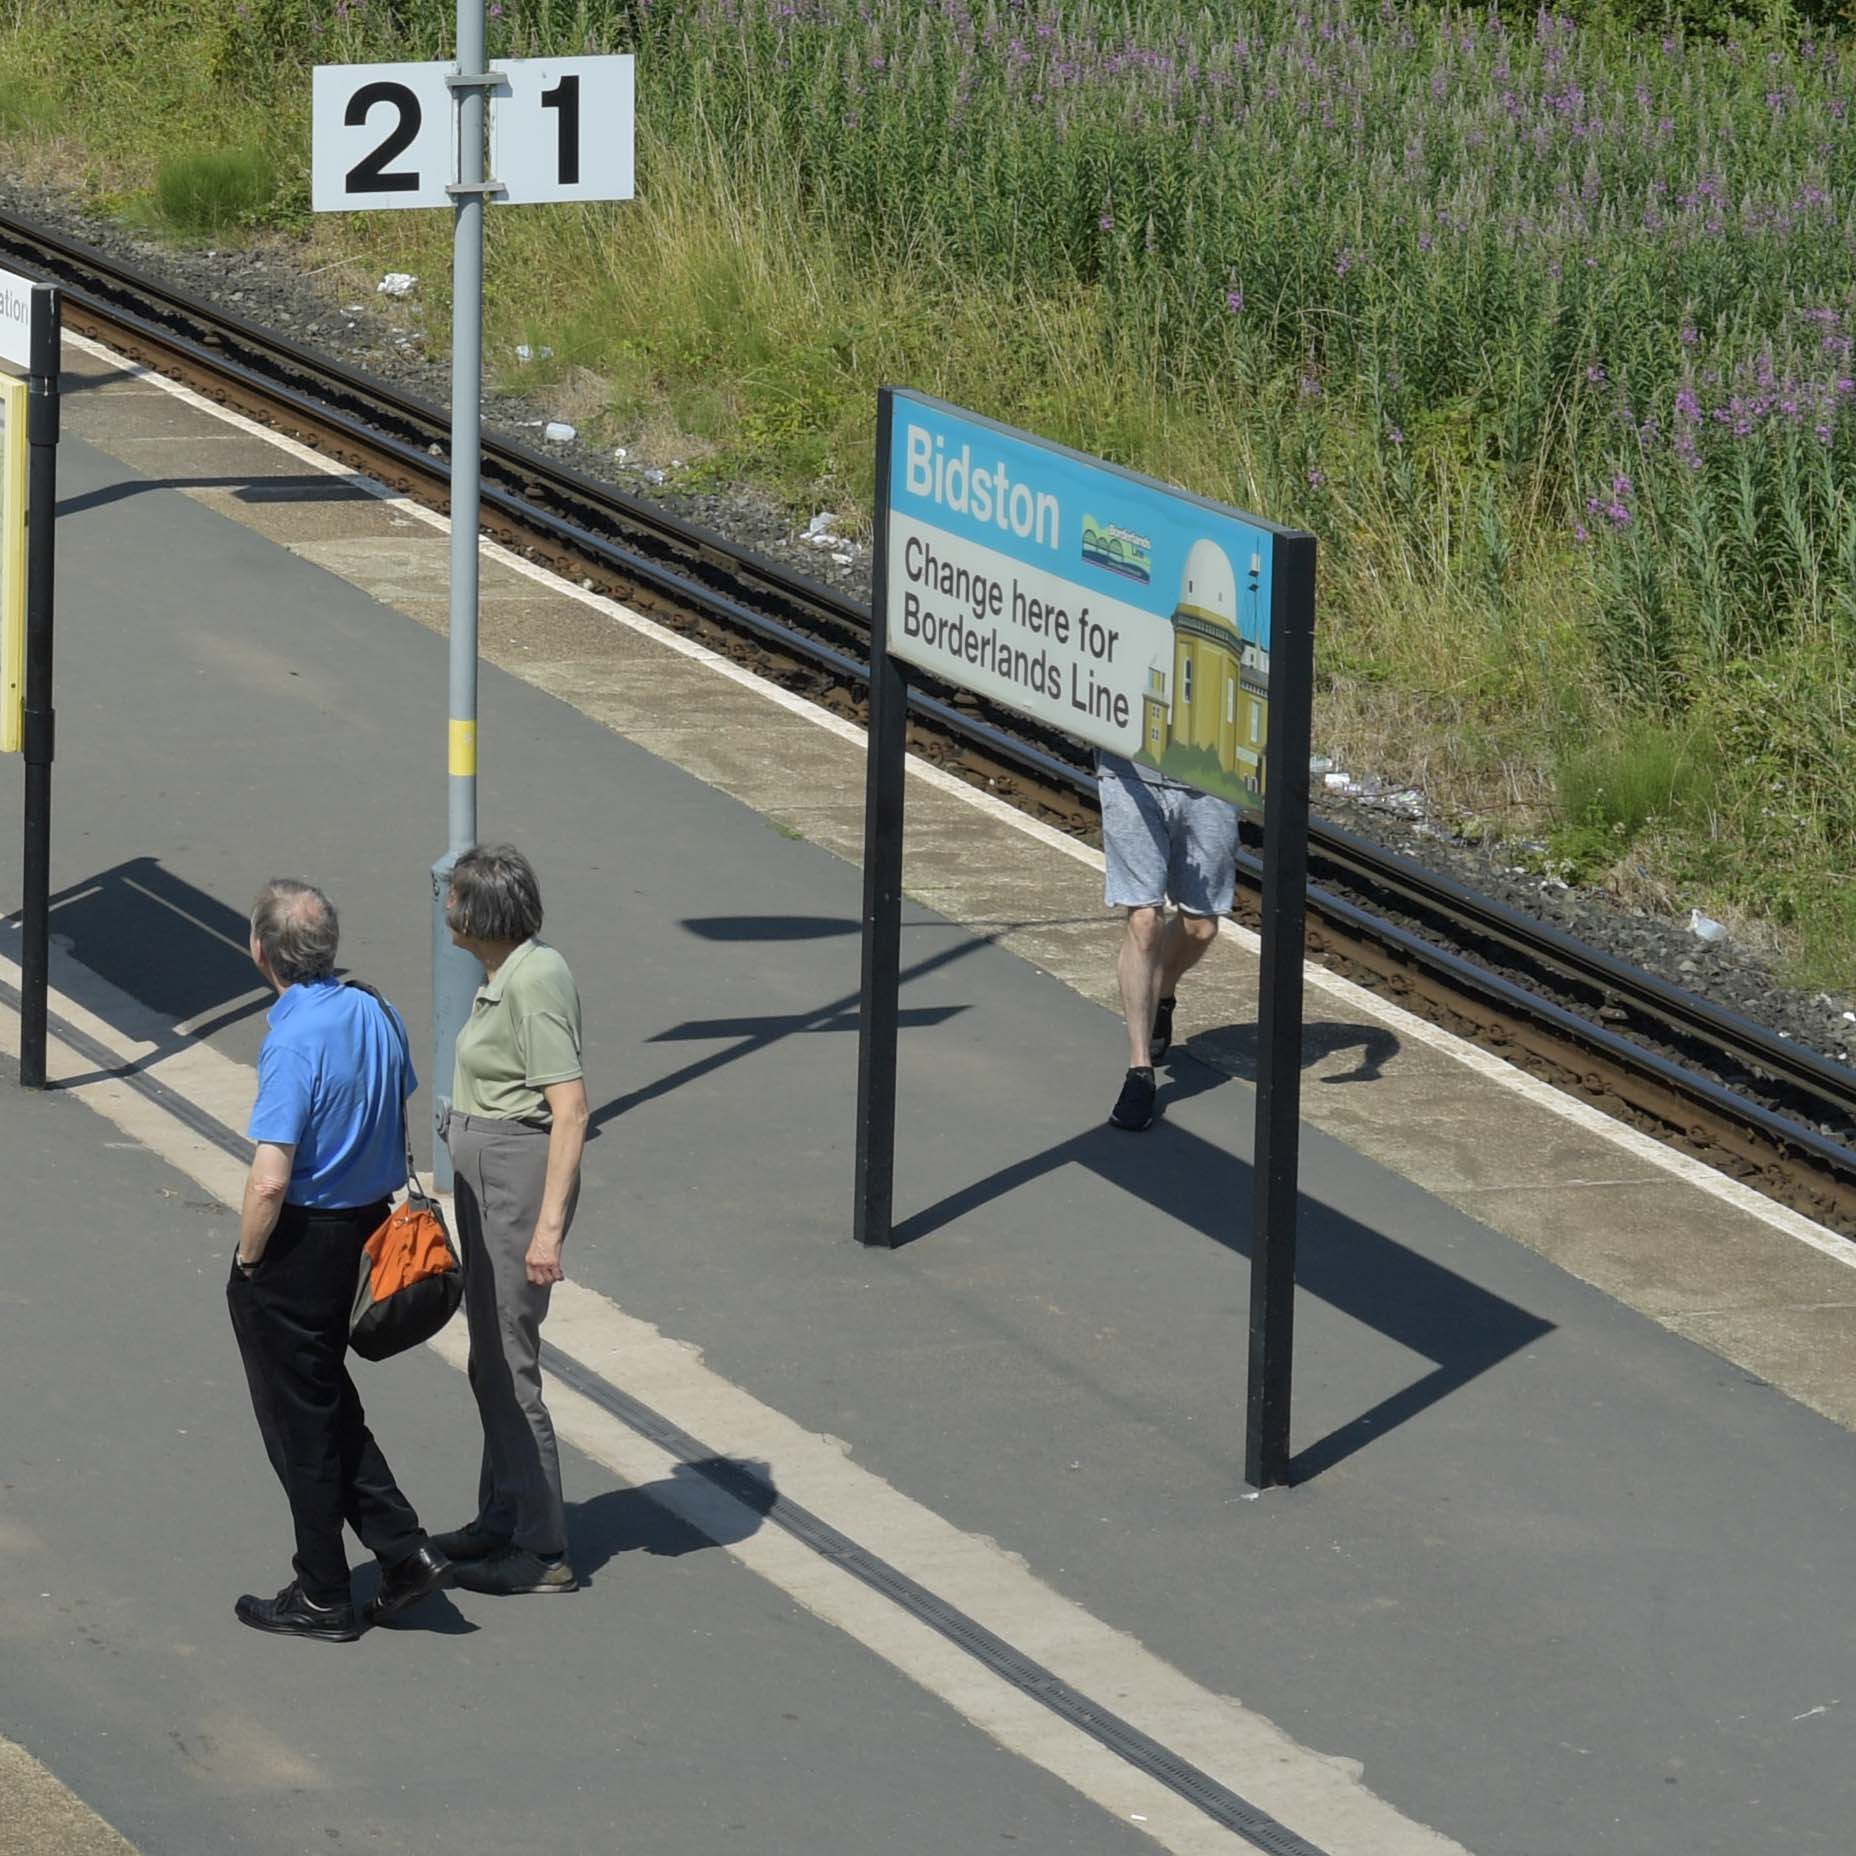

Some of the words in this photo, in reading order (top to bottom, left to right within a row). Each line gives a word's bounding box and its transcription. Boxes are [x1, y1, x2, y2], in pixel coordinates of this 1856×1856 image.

[343, 81, 422, 193] 2
[541, 75, 580, 185] 1
[906, 423, 1060, 550] Bidston
[904, 591, 1062, 701] Borderlands
[1071, 662, 1130, 729] Line
[905, 536, 1003, 619] Change
[1012, 578, 1070, 645] here
[1079, 606, 1120, 664] for
